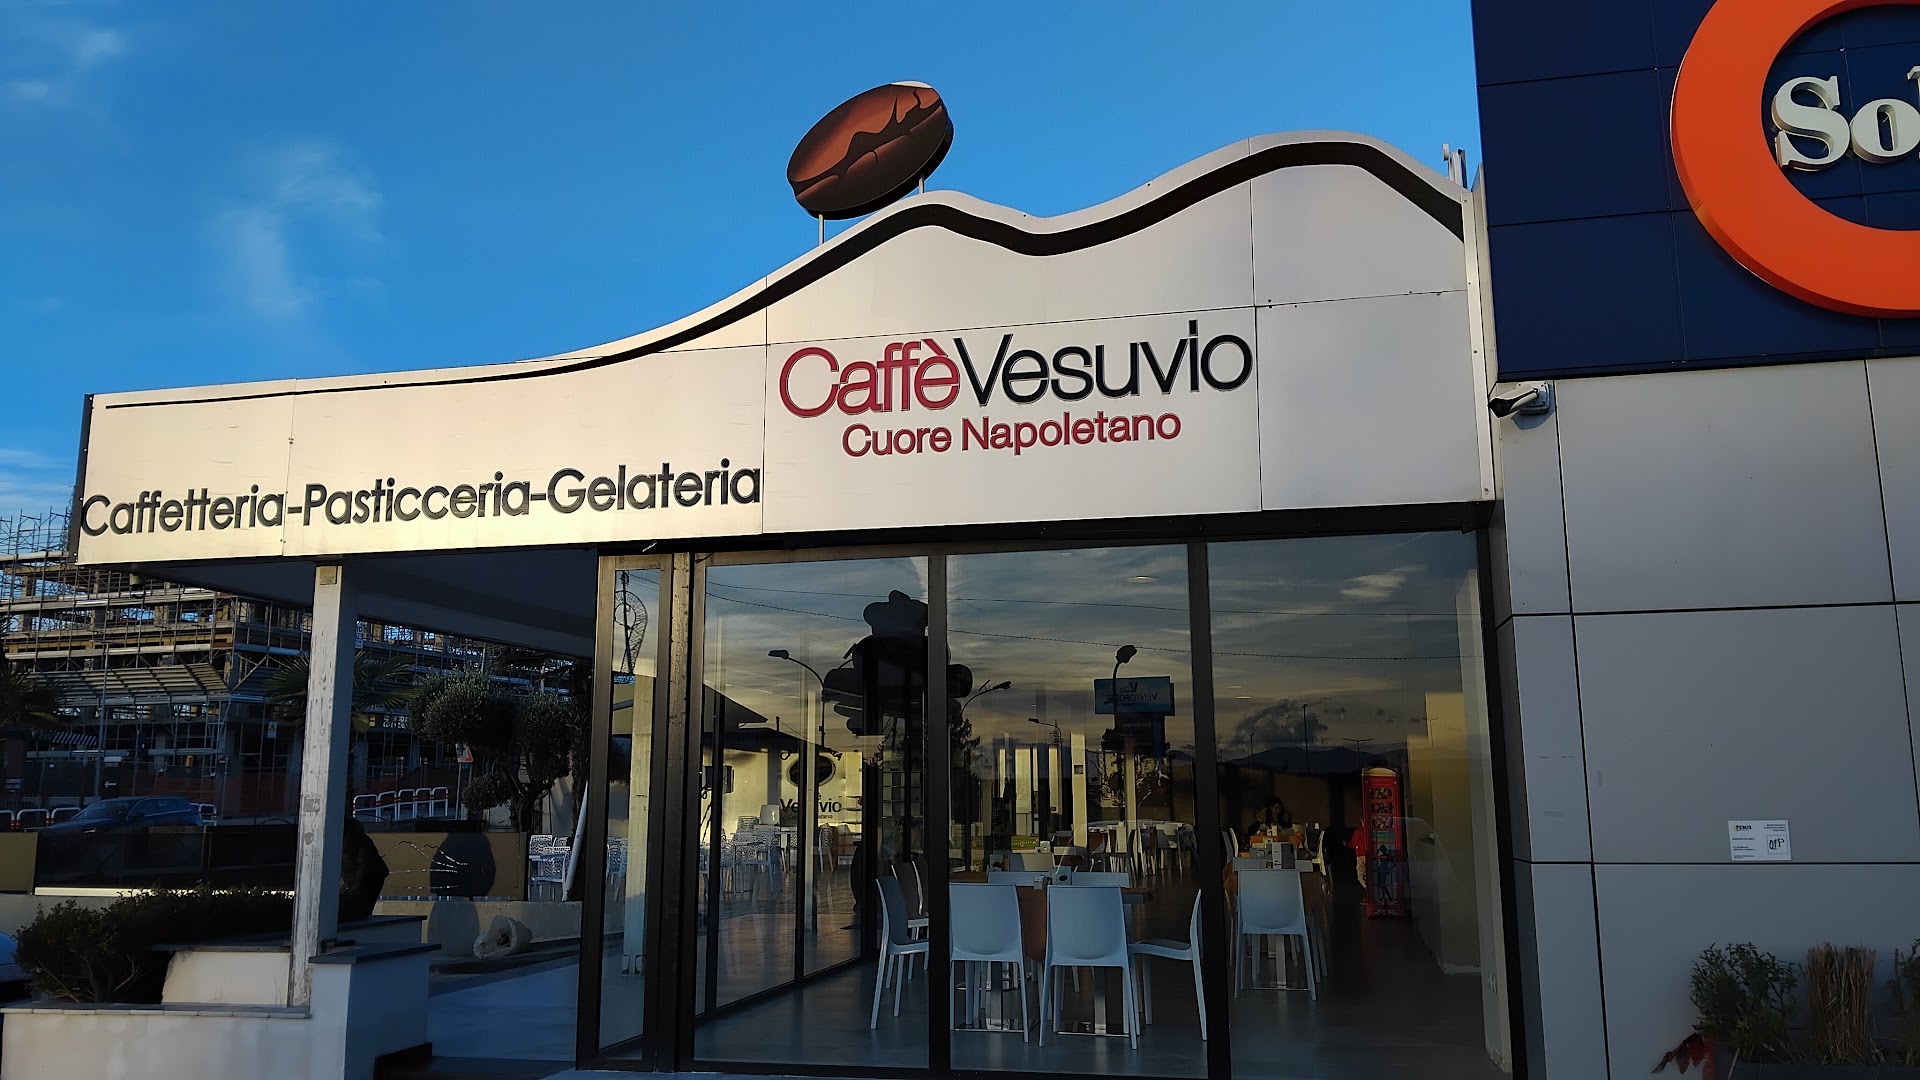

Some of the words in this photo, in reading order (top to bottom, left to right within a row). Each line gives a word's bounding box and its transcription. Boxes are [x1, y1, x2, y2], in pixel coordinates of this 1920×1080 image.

[1771, 66, 1920, 171] So
[842, 423, 952, 458] Cuore
[961, 411, 1182, 456] Napoletano
[780, 798, 842, 813] Vevio
